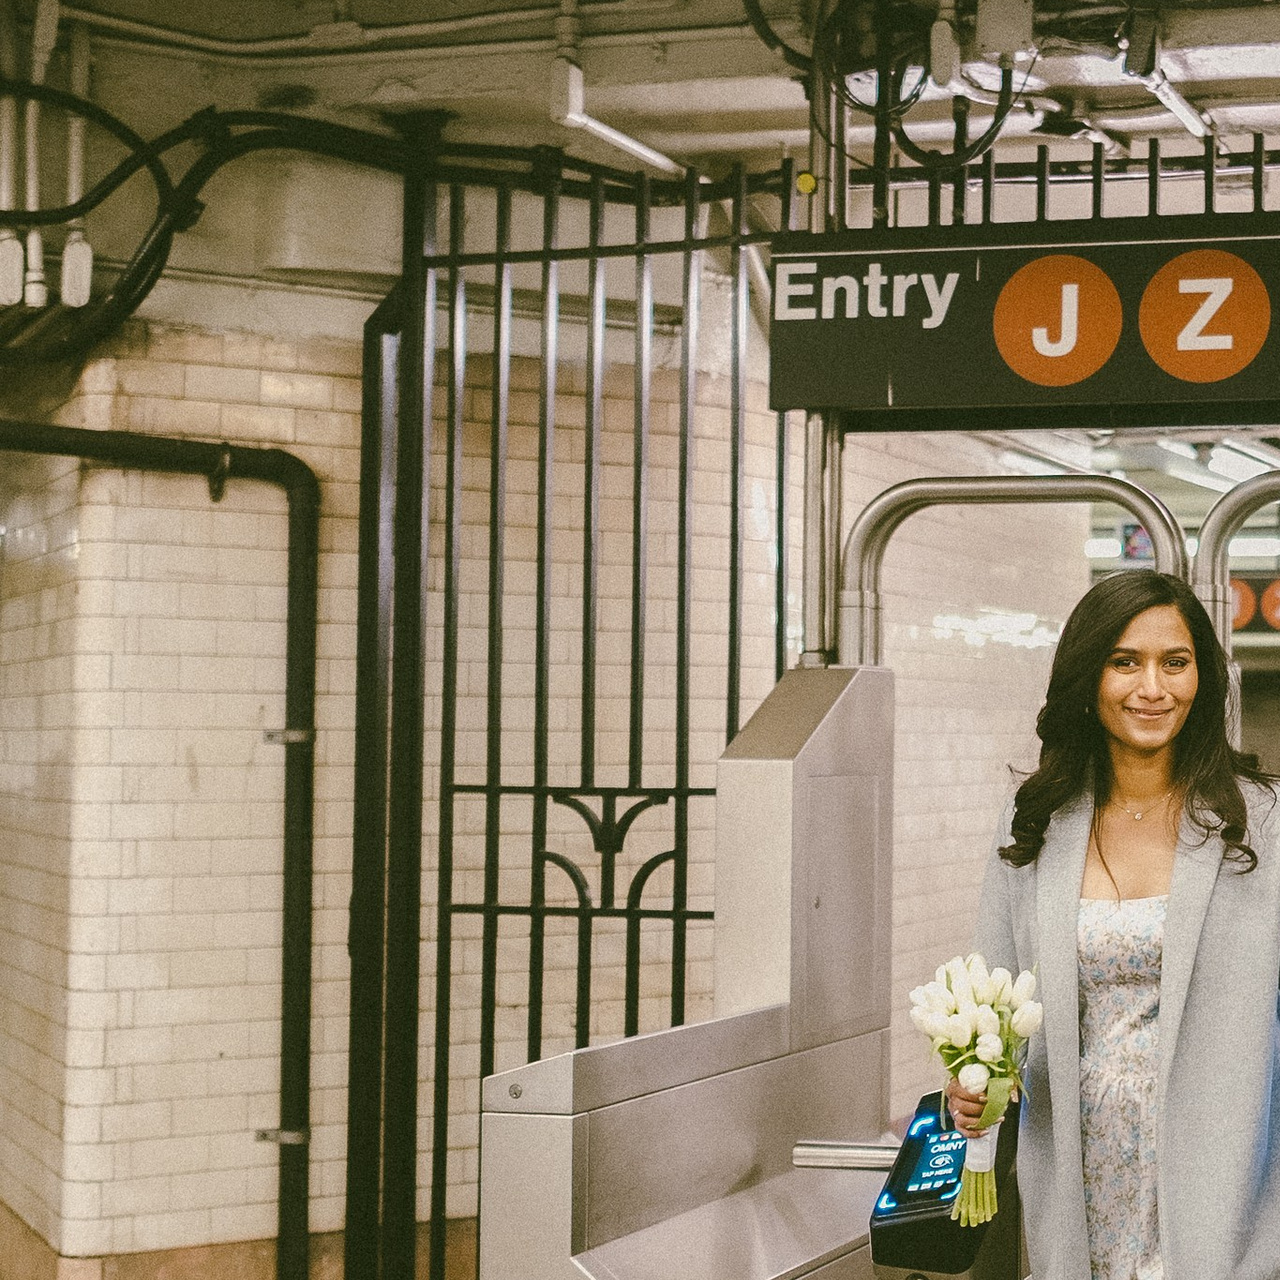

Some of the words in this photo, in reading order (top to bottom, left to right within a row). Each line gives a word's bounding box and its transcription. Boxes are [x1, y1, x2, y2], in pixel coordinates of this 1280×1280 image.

[774, 262, 960, 329] Entry
[1031, 283, 1080, 358] J
[1176, 277, 1234, 352] Z
[930, 1140, 967, 1154] OMNY
[921, 1170, 934, 1179] TAP
